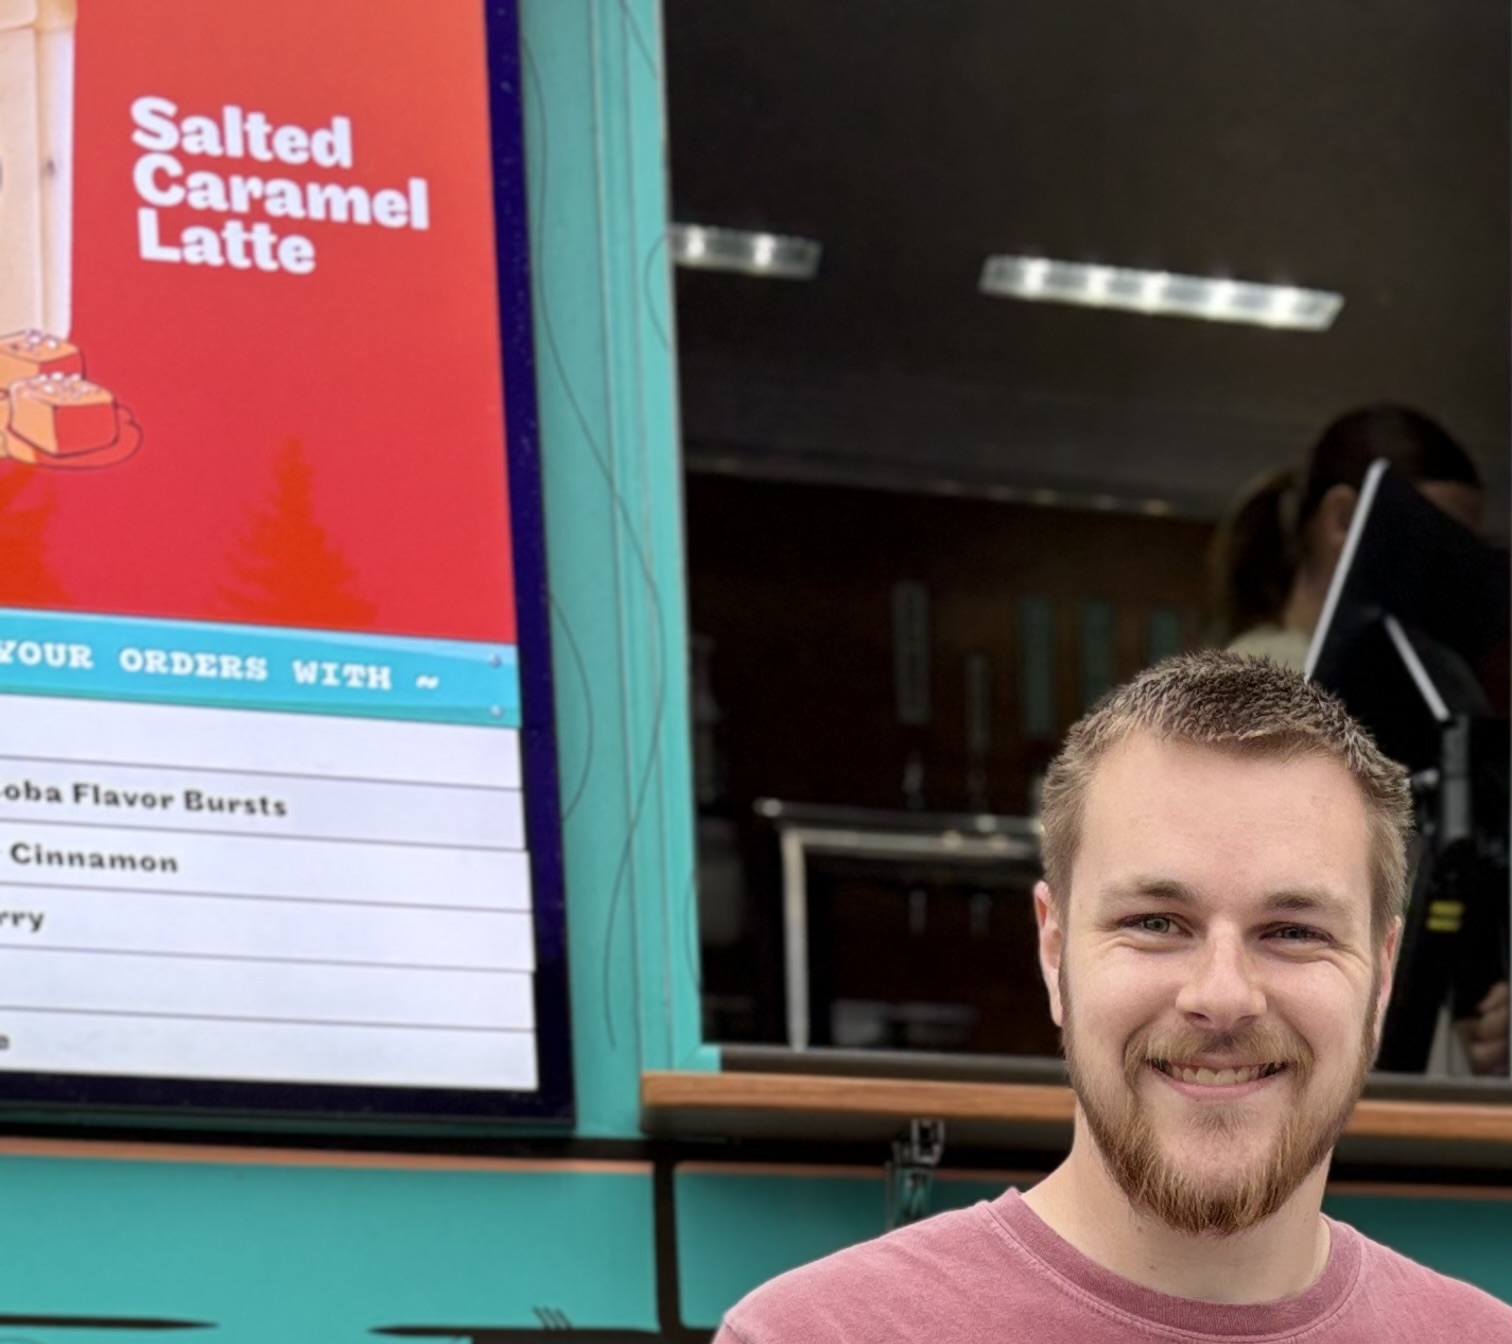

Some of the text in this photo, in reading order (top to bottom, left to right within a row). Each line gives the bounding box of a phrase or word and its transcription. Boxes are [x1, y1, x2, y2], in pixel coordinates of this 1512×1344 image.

[131, 97, 351, 167] Salted
[133, 154, 428, 229] Caramel
[138, 208, 315, 273] Latte
[0, 640, 94, 670] YOUR
[119, 648, 268, 681] ORDERS
[293, 660, 392, 690] WITH
[0, 781, 288, 818] oba Flavor Bursts
[11, 843, 179, 874] Cinnamon
